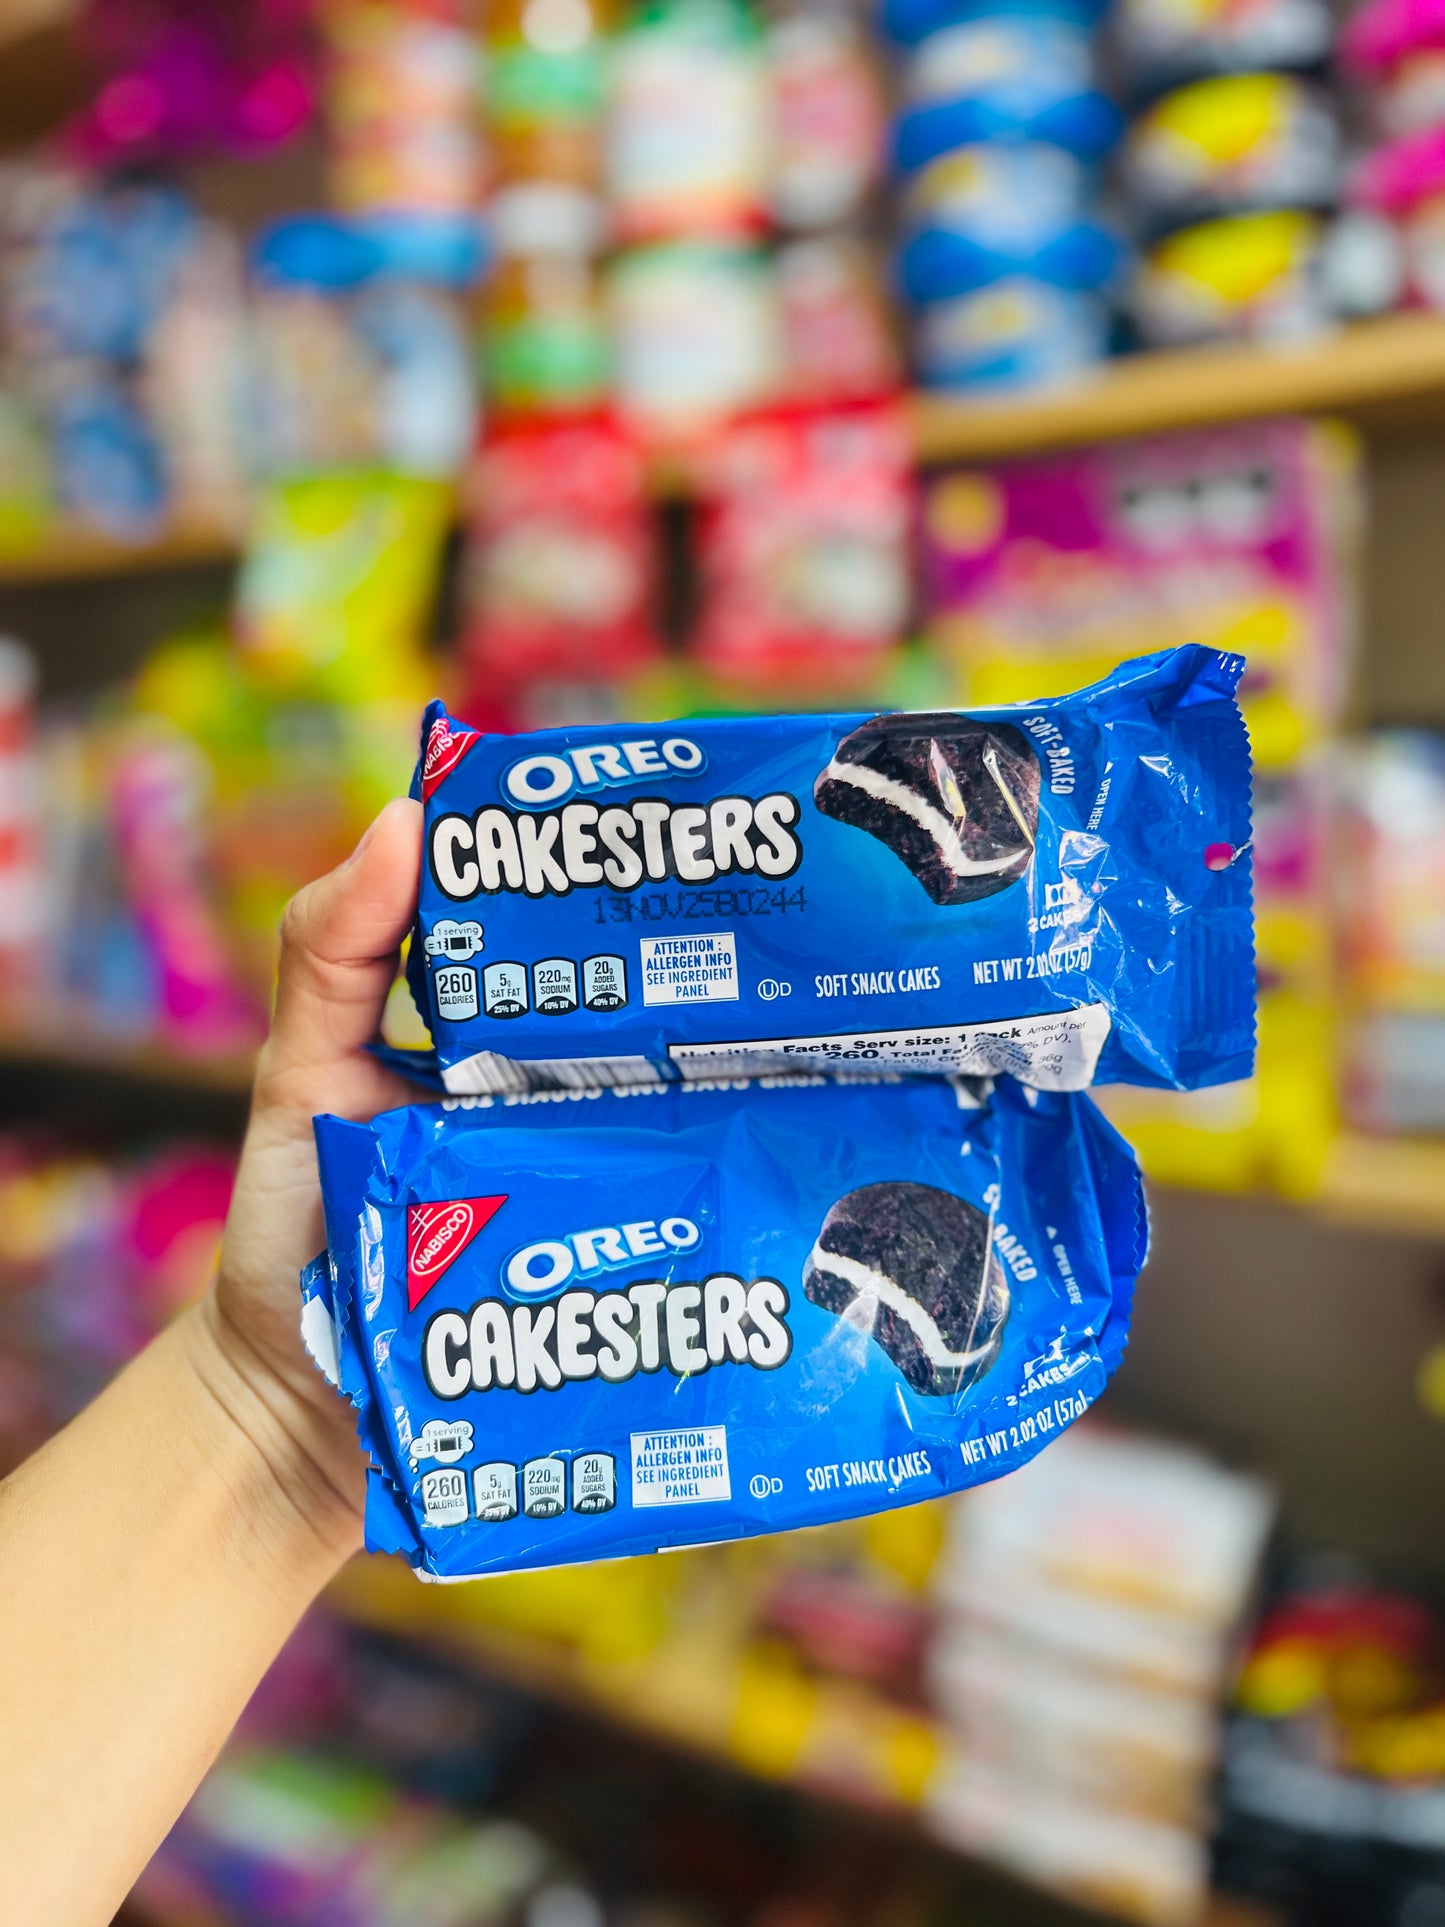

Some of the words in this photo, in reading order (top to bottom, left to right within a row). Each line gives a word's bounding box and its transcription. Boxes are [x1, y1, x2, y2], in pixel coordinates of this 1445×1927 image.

[1022, 716, 1076, 795] SOFT-BAKED
[506, 738, 703, 804] OREO
[1094, 778, 1112, 806] OPEN
[1086, 807, 1105, 831] HERE
[432, 794, 799, 898] CAKESTERS
[443, 926, 479, 936] serving
[653, 938, 715, 956] ATTENTION
[646, 955, 701, 972] ALLERGEN
[704, 953, 732, 967] INFO
[972, 960, 999, 985] NET
[1001, 957, 1024, 982] WT
[1064, 944, 1093, 974] (57g)
[438, 972, 472, 994] 260
[594, 976, 615, 984] ADDED
[646, 972, 666, 986] SEE
[668, 967, 733, 984] INGREDIENT
[815, 974, 848, 998] SOFT
[850, 970, 896, 996] SNACK
[898, 965, 941, 993] CAKES
[490, 989, 505, 999] SAT
[507, 987, 521, 997] FAT
[540, 985, 571, 995] SODIUM
[592, 984, 618, 993] SUGARS
[675, 983, 710, 998] PANEL
[439, 995, 475, 1005] CALORIES
[783, 1043, 842, 1054] Facts
[853, 1040, 898, 1050] Serv
[904, 1035, 951, 1046] size:
[957, 1033, 967, 1043] 1
[1026, 1021, 1067, 1036] Amount
[1068, 1021, 1087, 1031] per
[890, 1049, 936, 1058] Total
[414, 1208, 468, 1270] NABISCO
[506, 1217, 700, 1293] OREO
[1064, 1276, 1084, 1304] HERE
[426, 1276, 790, 1397] CAKESTERS
[433, 1426, 470, 1437] serving
[960, 1437, 987, 1466] NET
[985, 1429, 1009, 1457] WT
[1009, 1416, 1038, 1448] 2.02
[1036, 1407, 1056, 1433] OZ
[644, 1433, 705, 1451] ATTENTION
[636, 1450, 692, 1468] ALLERGEN
[695, 1447, 722, 1463] INFO
[583, 1474, 604, 1484] ADDED
[636, 1470, 655, 1484] SEE
[658, 1463, 724, 1482] INGREDIENT
[805, 1464, 841, 1493] SOFT
[845, 1459, 887, 1486] SNACK
[887, 1449, 932, 1482] CAKES
[427, 1475, 462, 1499] 260
[481, 1490, 496, 1501] SAT
[497, 1489, 512, 1498] FAT
[529, 1485, 560, 1496] SODIUM
[581, 1483, 606, 1493] SUGARS
[665, 1483, 700, 1498] PANEL
[427, 1499, 465, 1510] CALORIES
